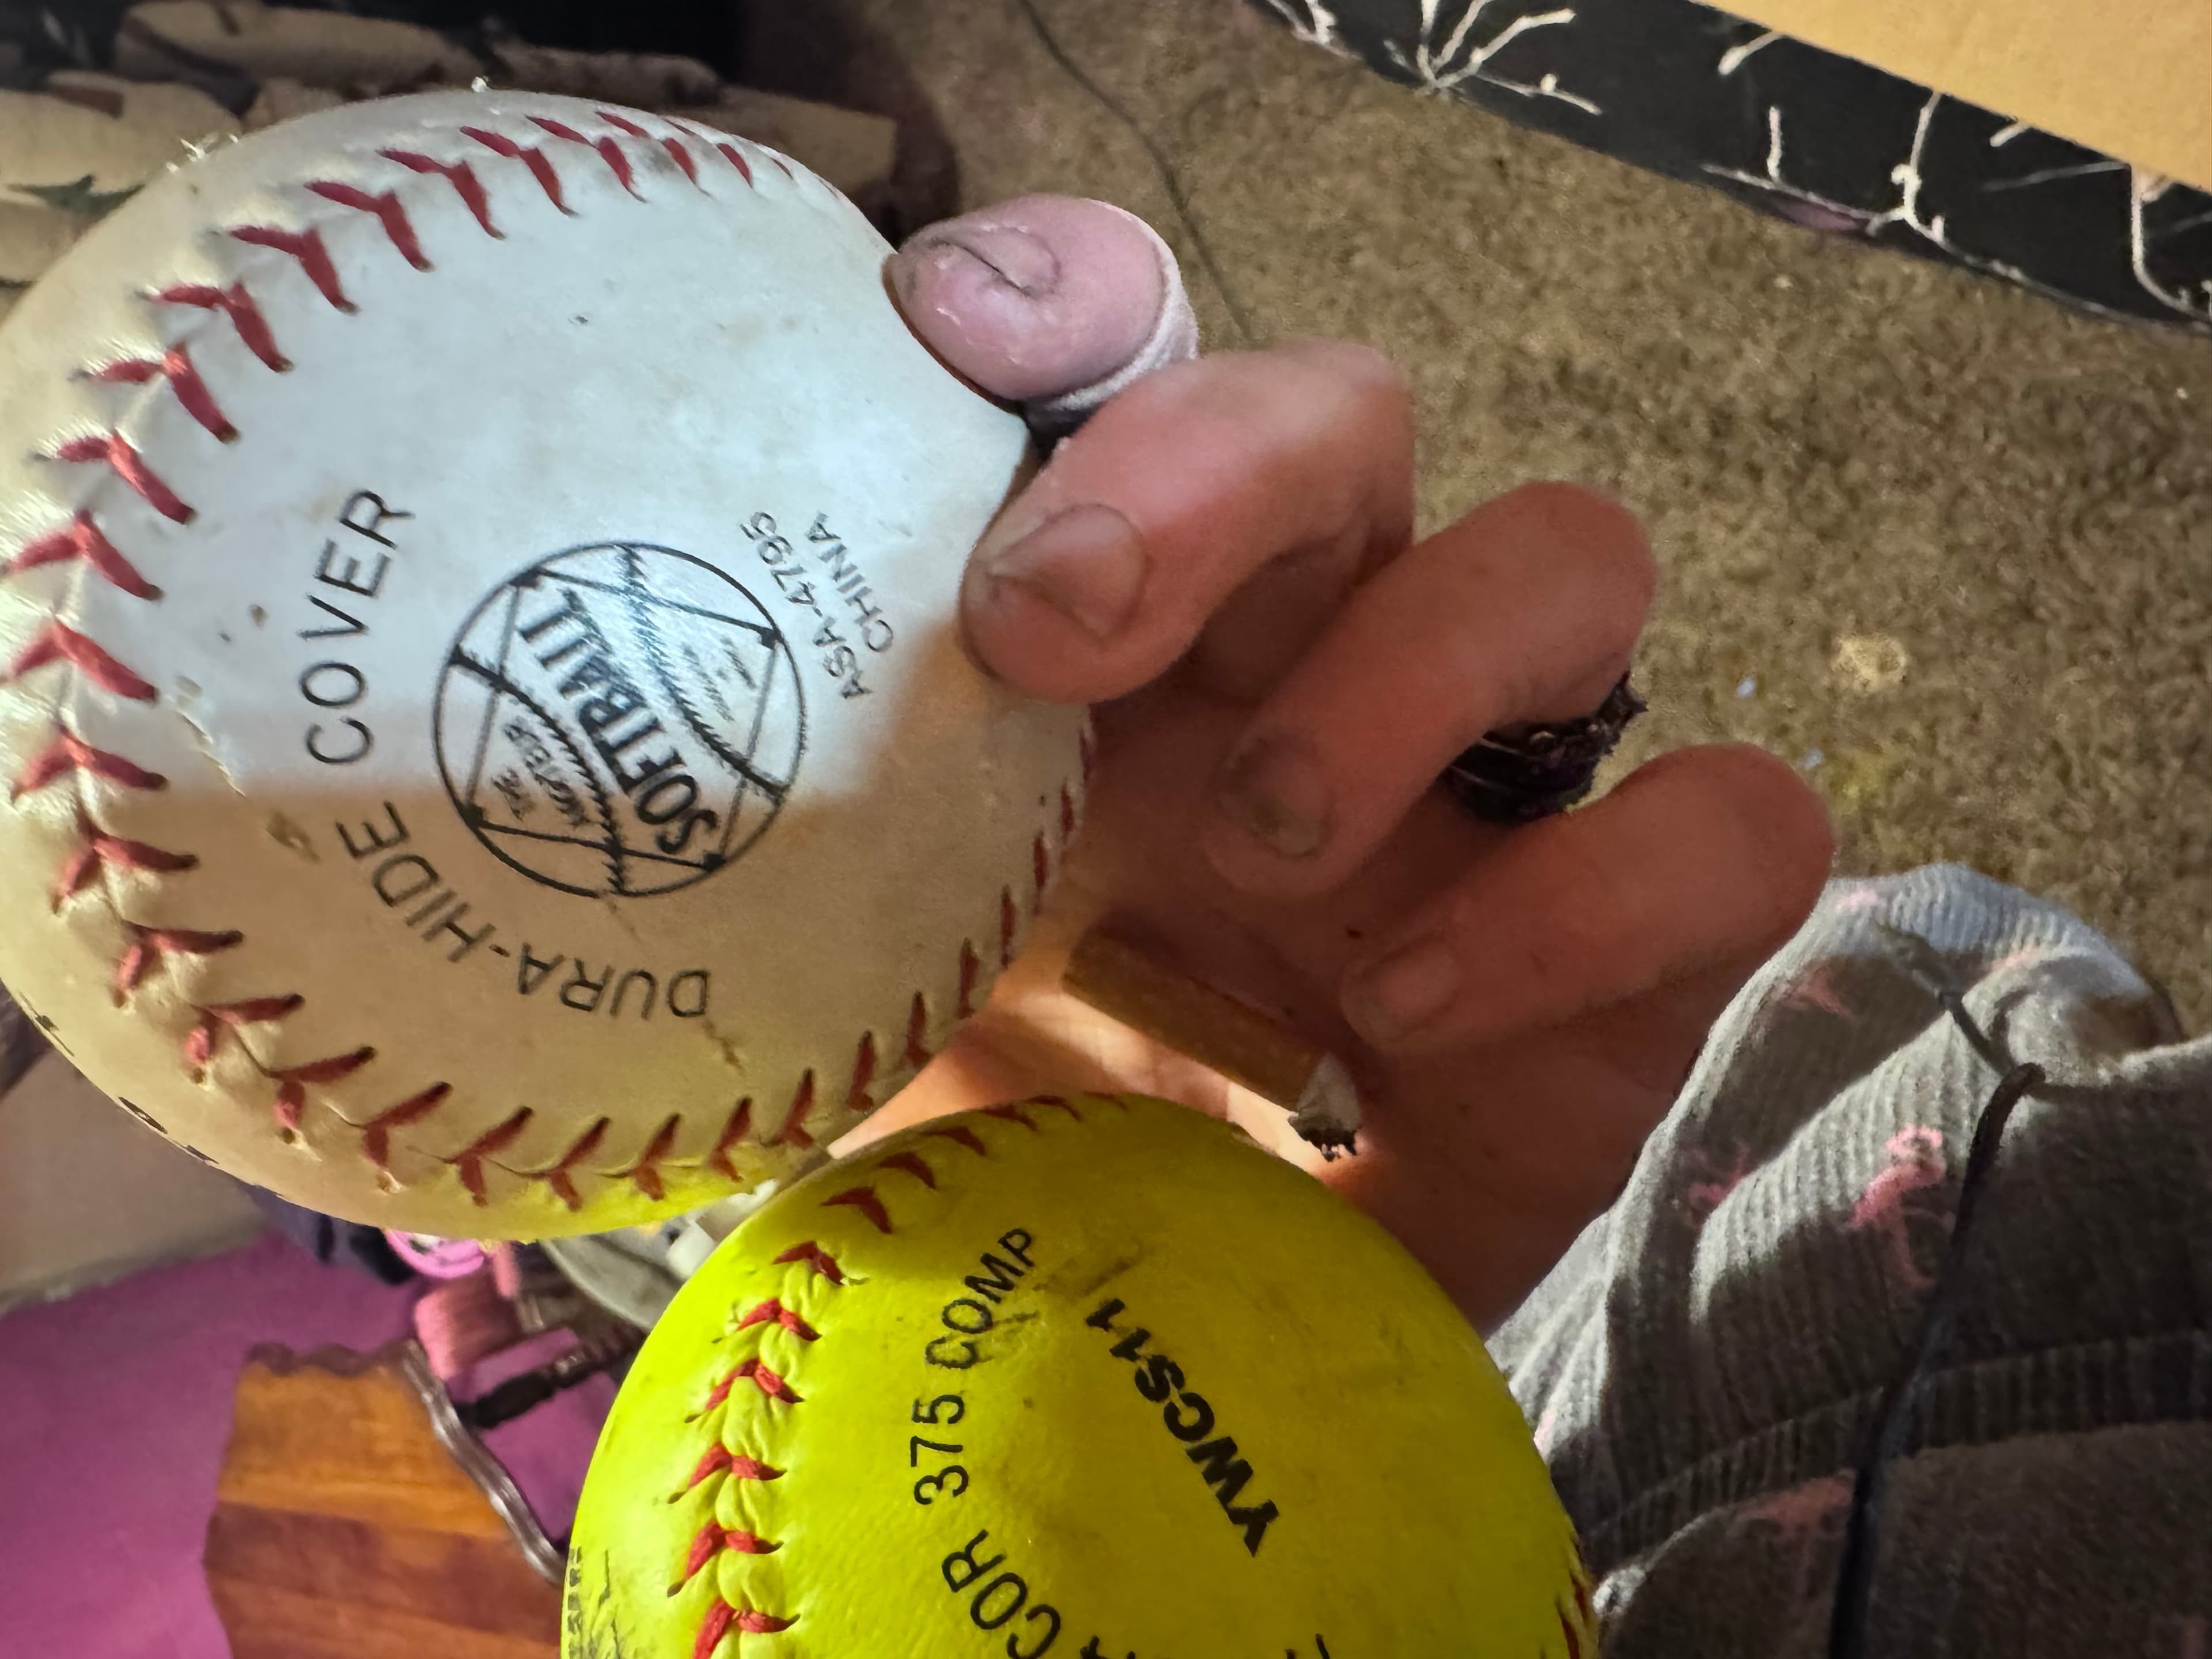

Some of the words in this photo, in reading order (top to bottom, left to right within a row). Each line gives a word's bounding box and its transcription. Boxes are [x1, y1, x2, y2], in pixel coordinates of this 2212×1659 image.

[297, 490, 415, 764] COVER
[739, 512, 873, 699] ASA-4795
[806, 511, 893, 652] CHINA
[521, 587, 718, 854] SOFTBALL
[335, 801, 712, 1019] DURA-HIDE
[925, 1228, 1035, 1370] COMP
[910, 1393, 969, 1505] 375
[1085, 1298, 1280, 1558] YWCS11
[941, 1529, 1061, 1659] COR
